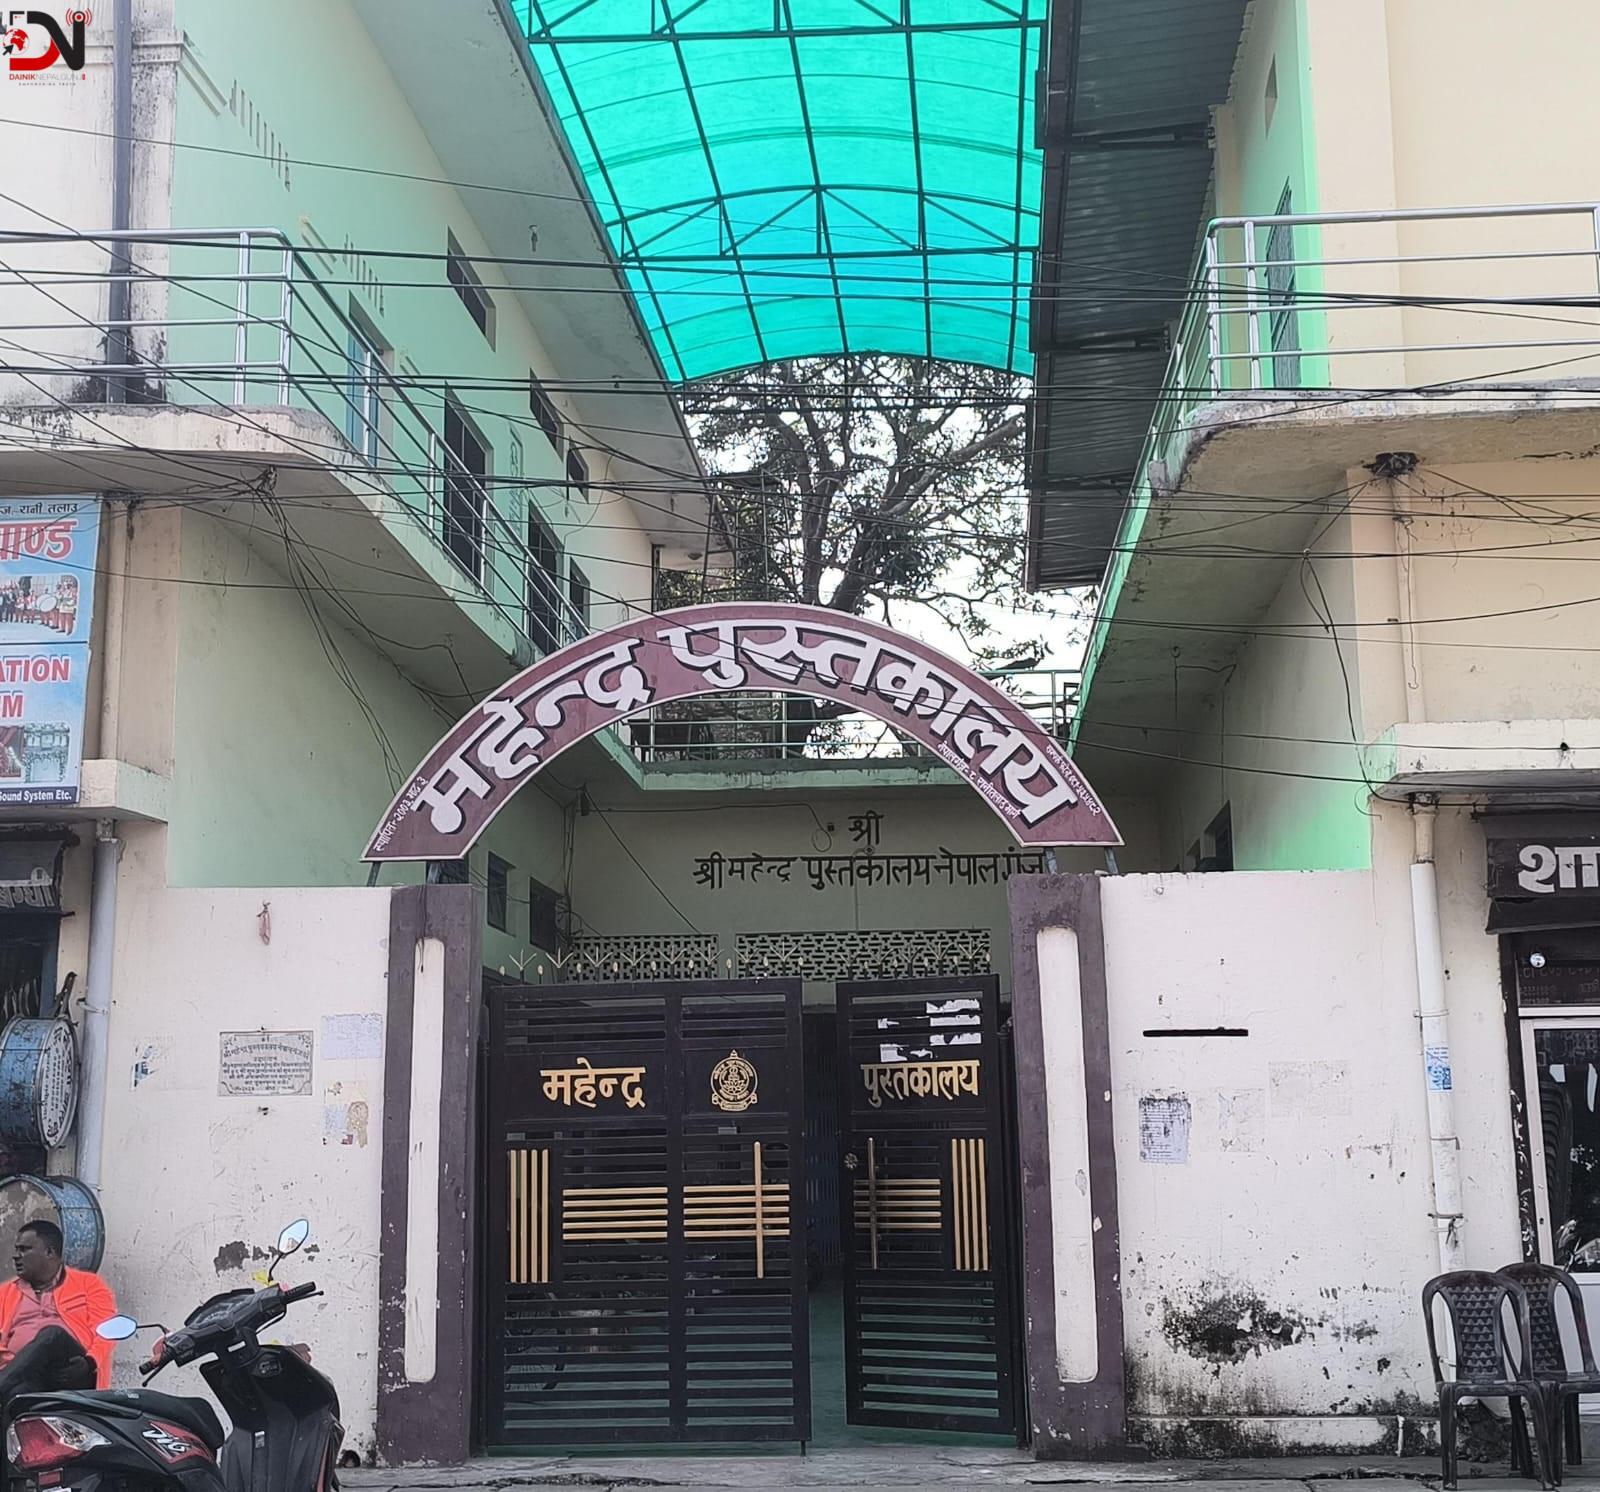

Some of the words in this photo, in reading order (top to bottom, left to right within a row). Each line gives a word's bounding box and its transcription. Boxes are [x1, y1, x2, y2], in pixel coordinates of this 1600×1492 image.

[19, 502, 43, 514] रानी
[48, 503, 78, 514] तलाउ
[0, 694, 24, 718] M
[410, 637, 653, 835] महेन्द्र
[656, 618, 1077, 827] पुस्तकालय
[23, 790, 54, 804] System
[55, 789, 72, 800] Etc.
[848, 810, 885, 846] श्री
[693, 851, 726, 890] श्री
[727, 852, 799, 883] महेन्द्र
[801, 853, 937, 891] पुस्तकालय
[540, 1056, 647, 1109] महेन्द्र
[860, 1059, 980, 1109] पुस्तकालय
